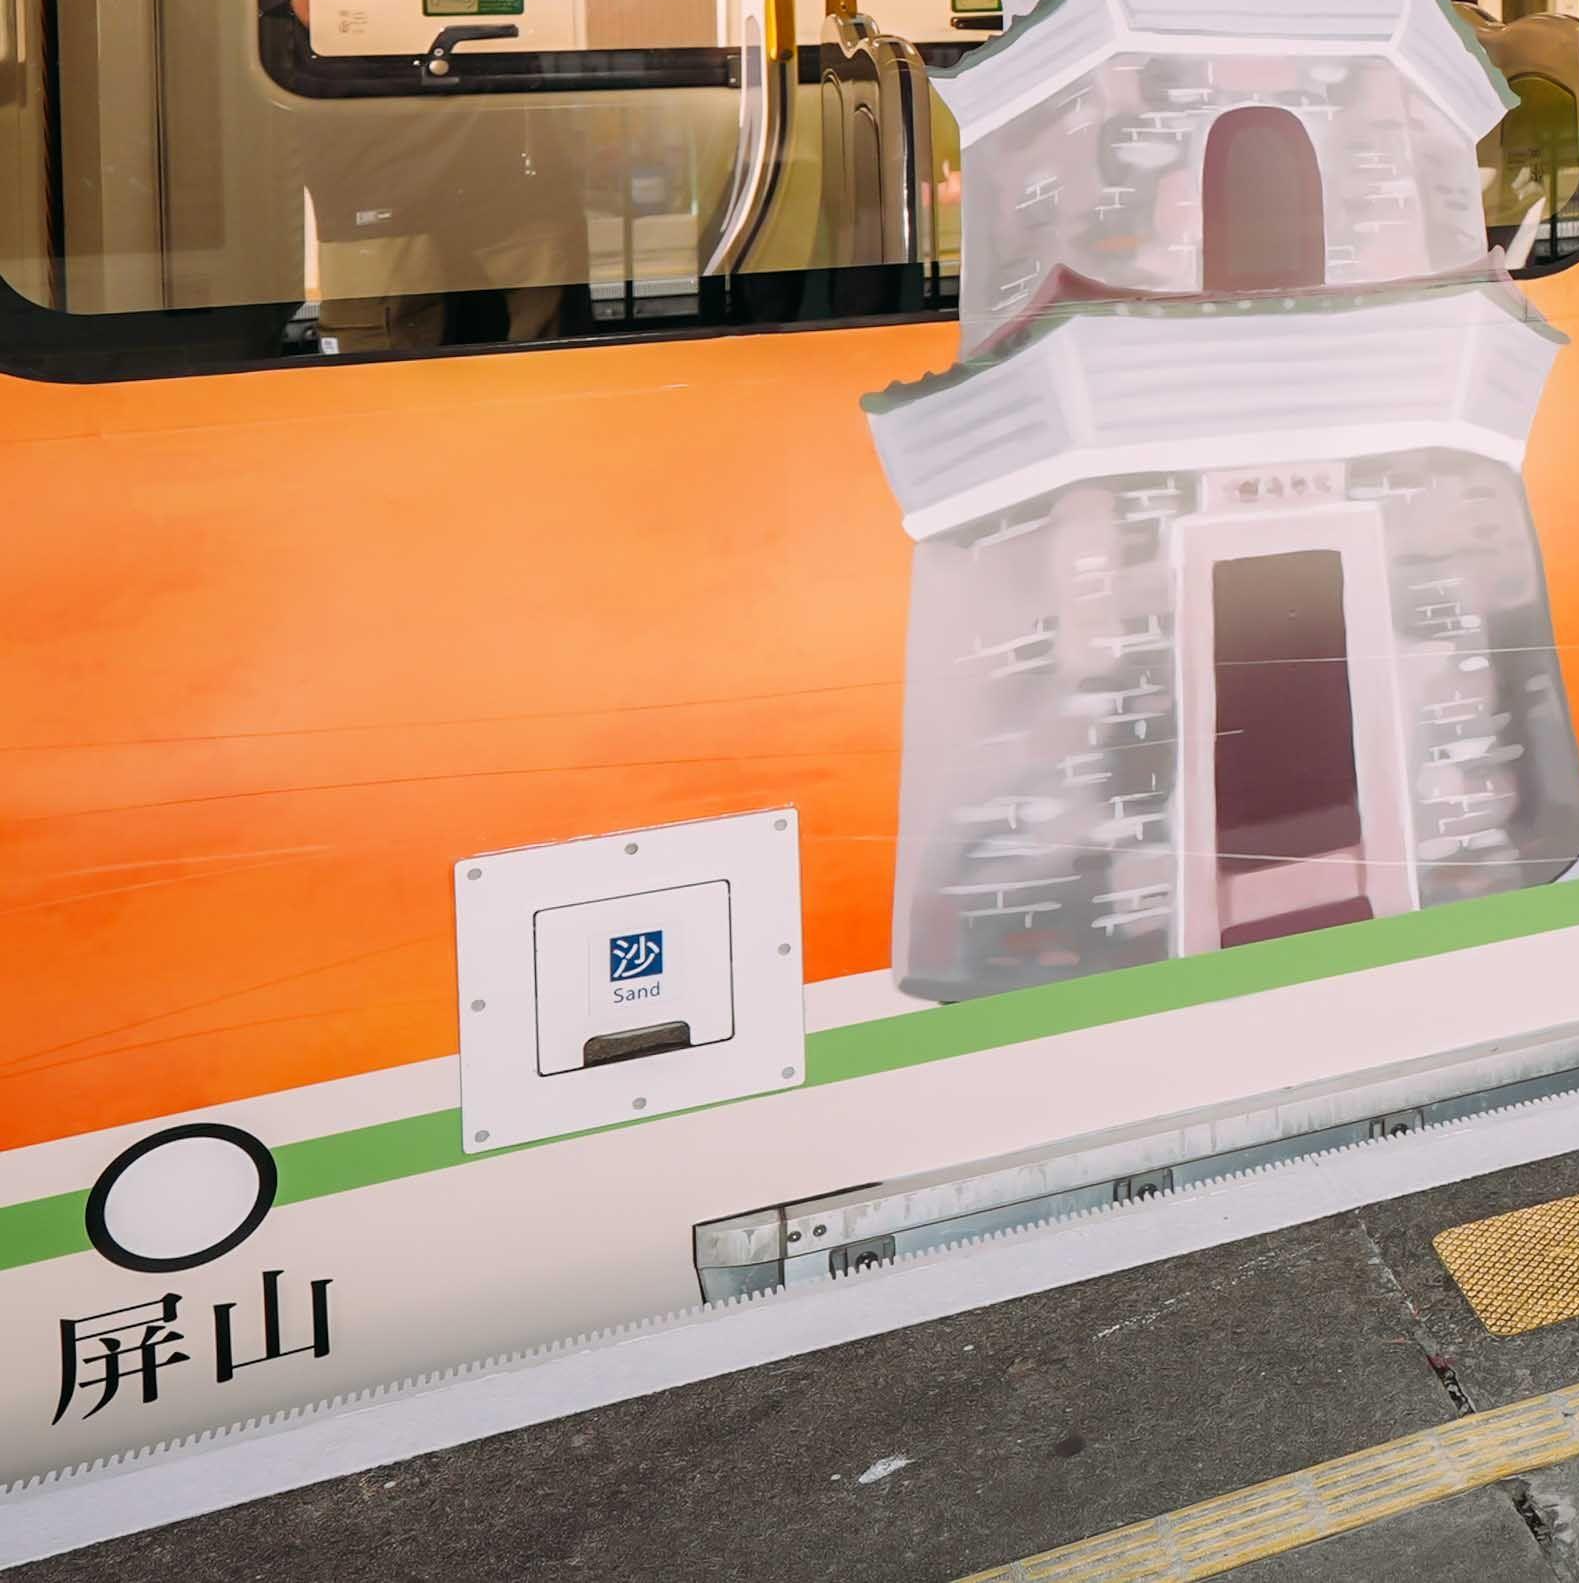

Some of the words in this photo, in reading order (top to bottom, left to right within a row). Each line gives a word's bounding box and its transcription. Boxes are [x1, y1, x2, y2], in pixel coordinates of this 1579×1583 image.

[611, 934, 662, 979] 沙
[613, 981, 661, 1004] Sand
[50, 1269, 335, 1427] 屏山
